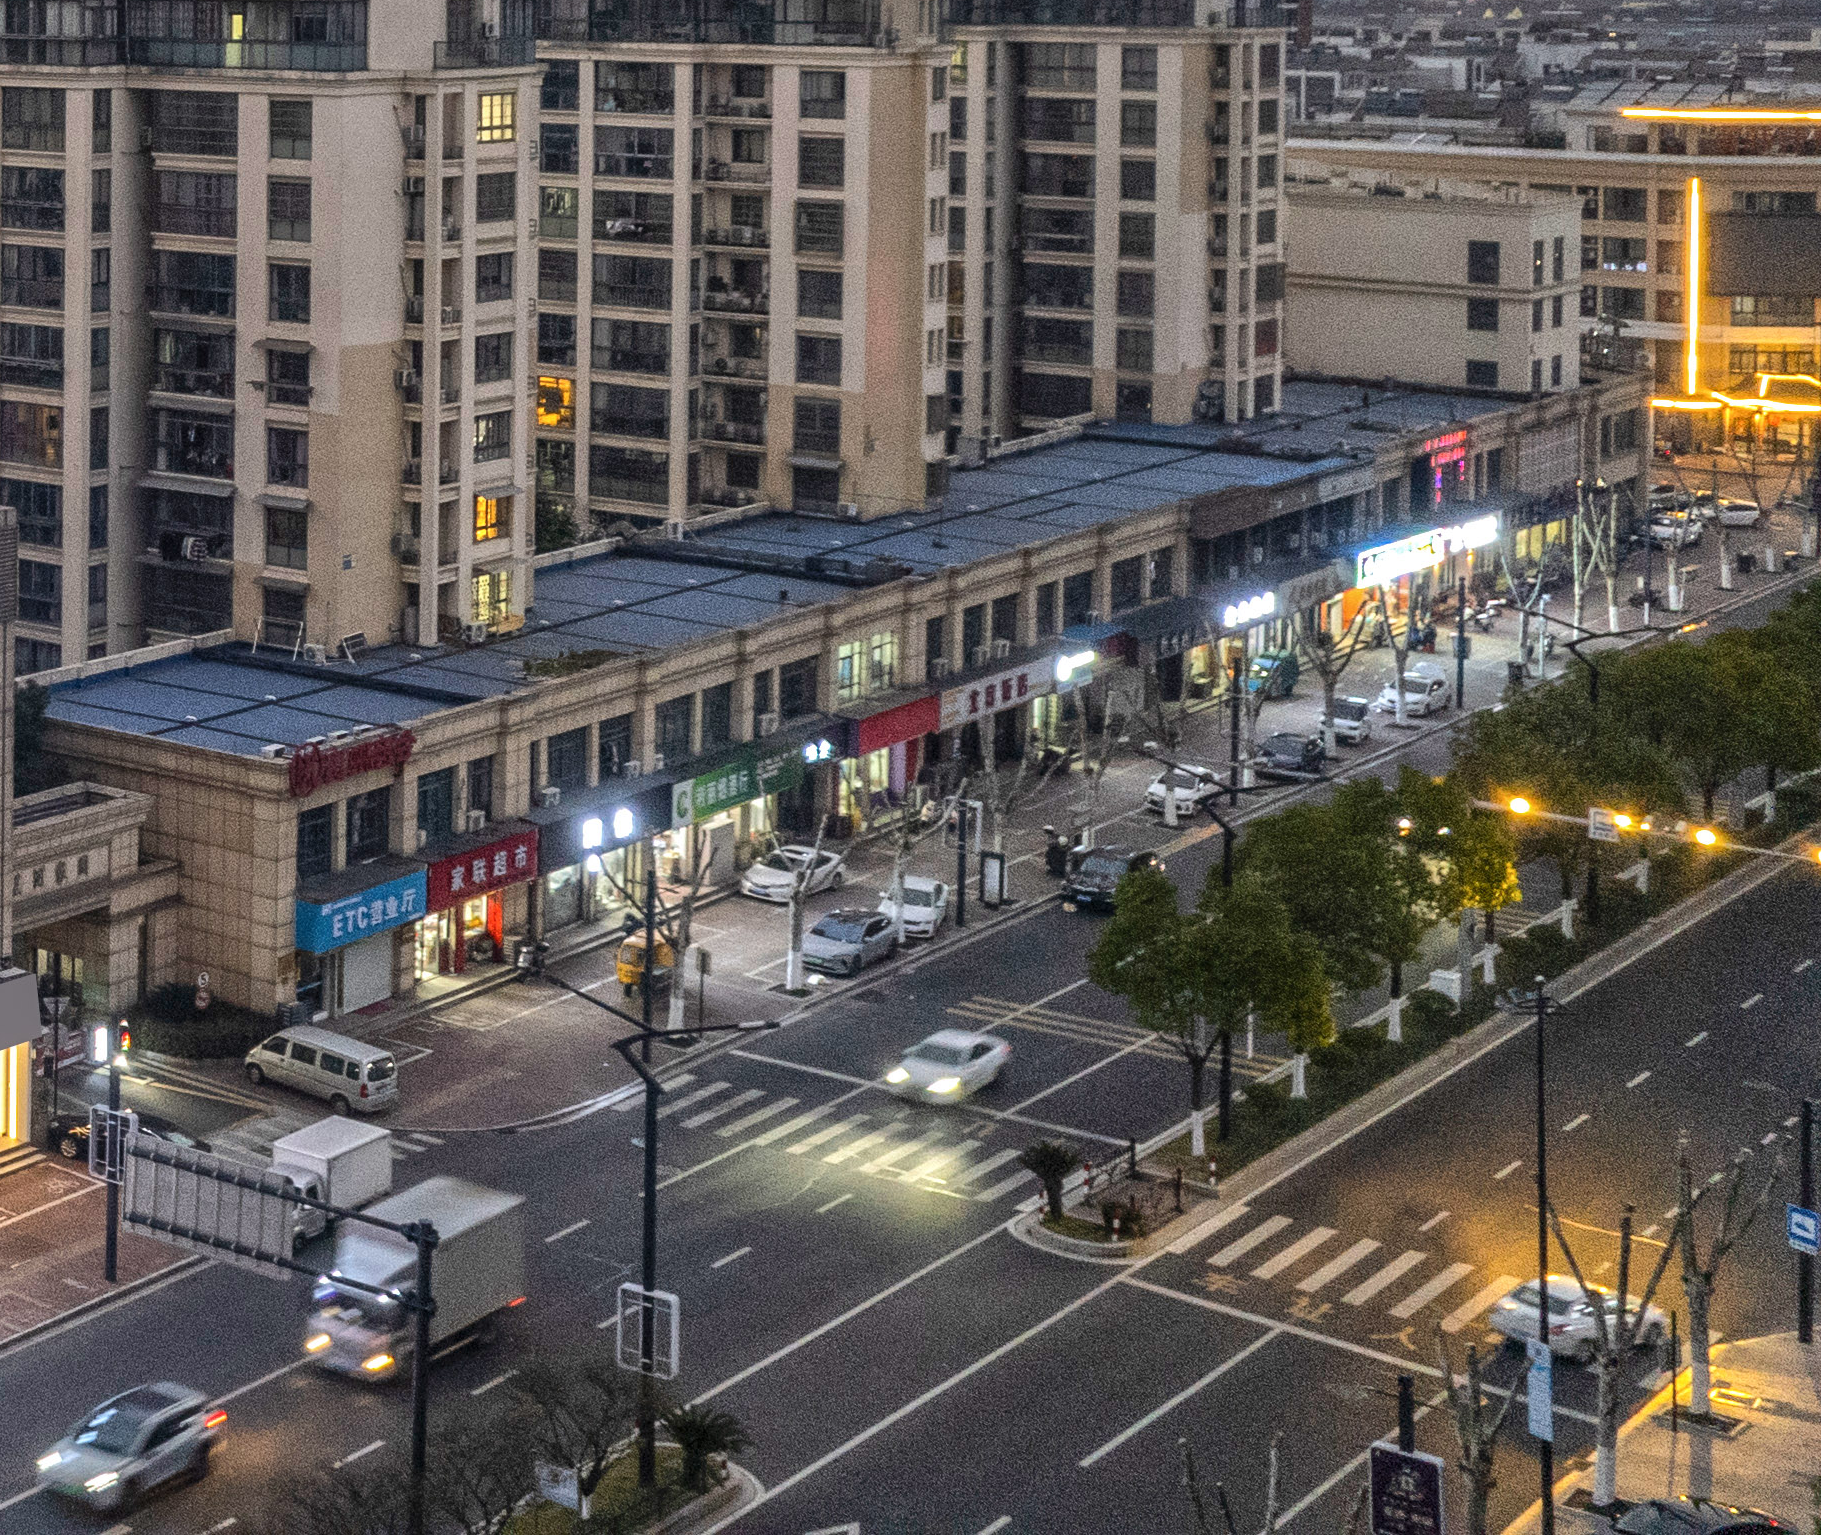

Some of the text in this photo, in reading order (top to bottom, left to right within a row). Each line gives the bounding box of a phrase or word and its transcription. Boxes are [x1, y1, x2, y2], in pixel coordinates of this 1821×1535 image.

[450, 845, 528, 892] 家联超市
[332, 888, 417, 938] ETC营业厅
